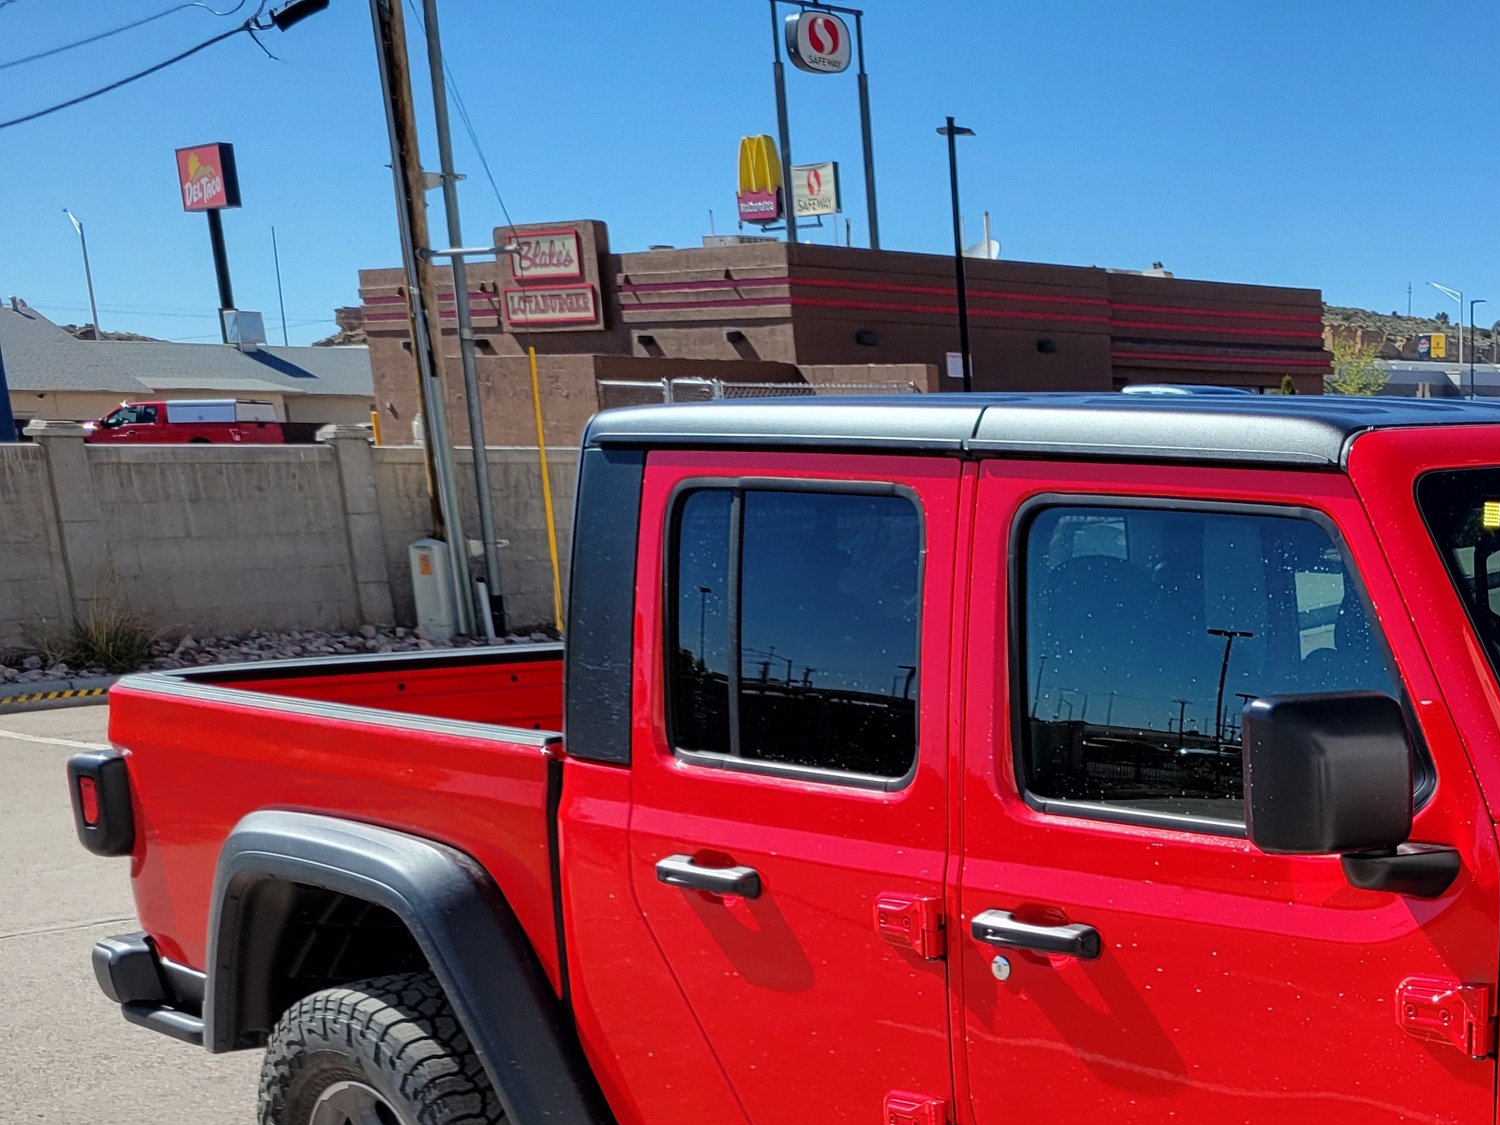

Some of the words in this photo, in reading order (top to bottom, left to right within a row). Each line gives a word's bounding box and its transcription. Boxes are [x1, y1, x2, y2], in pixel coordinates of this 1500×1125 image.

[808, 54, 841, 68] SAFEWAY
[184, 181, 203, 206] DEL
[200, 176, 221, 203] TACO
[798, 197, 831, 212] SAFEWAY
[519, 240, 575, 271] Blake's
[509, 293, 591, 315] LOTABURGER
